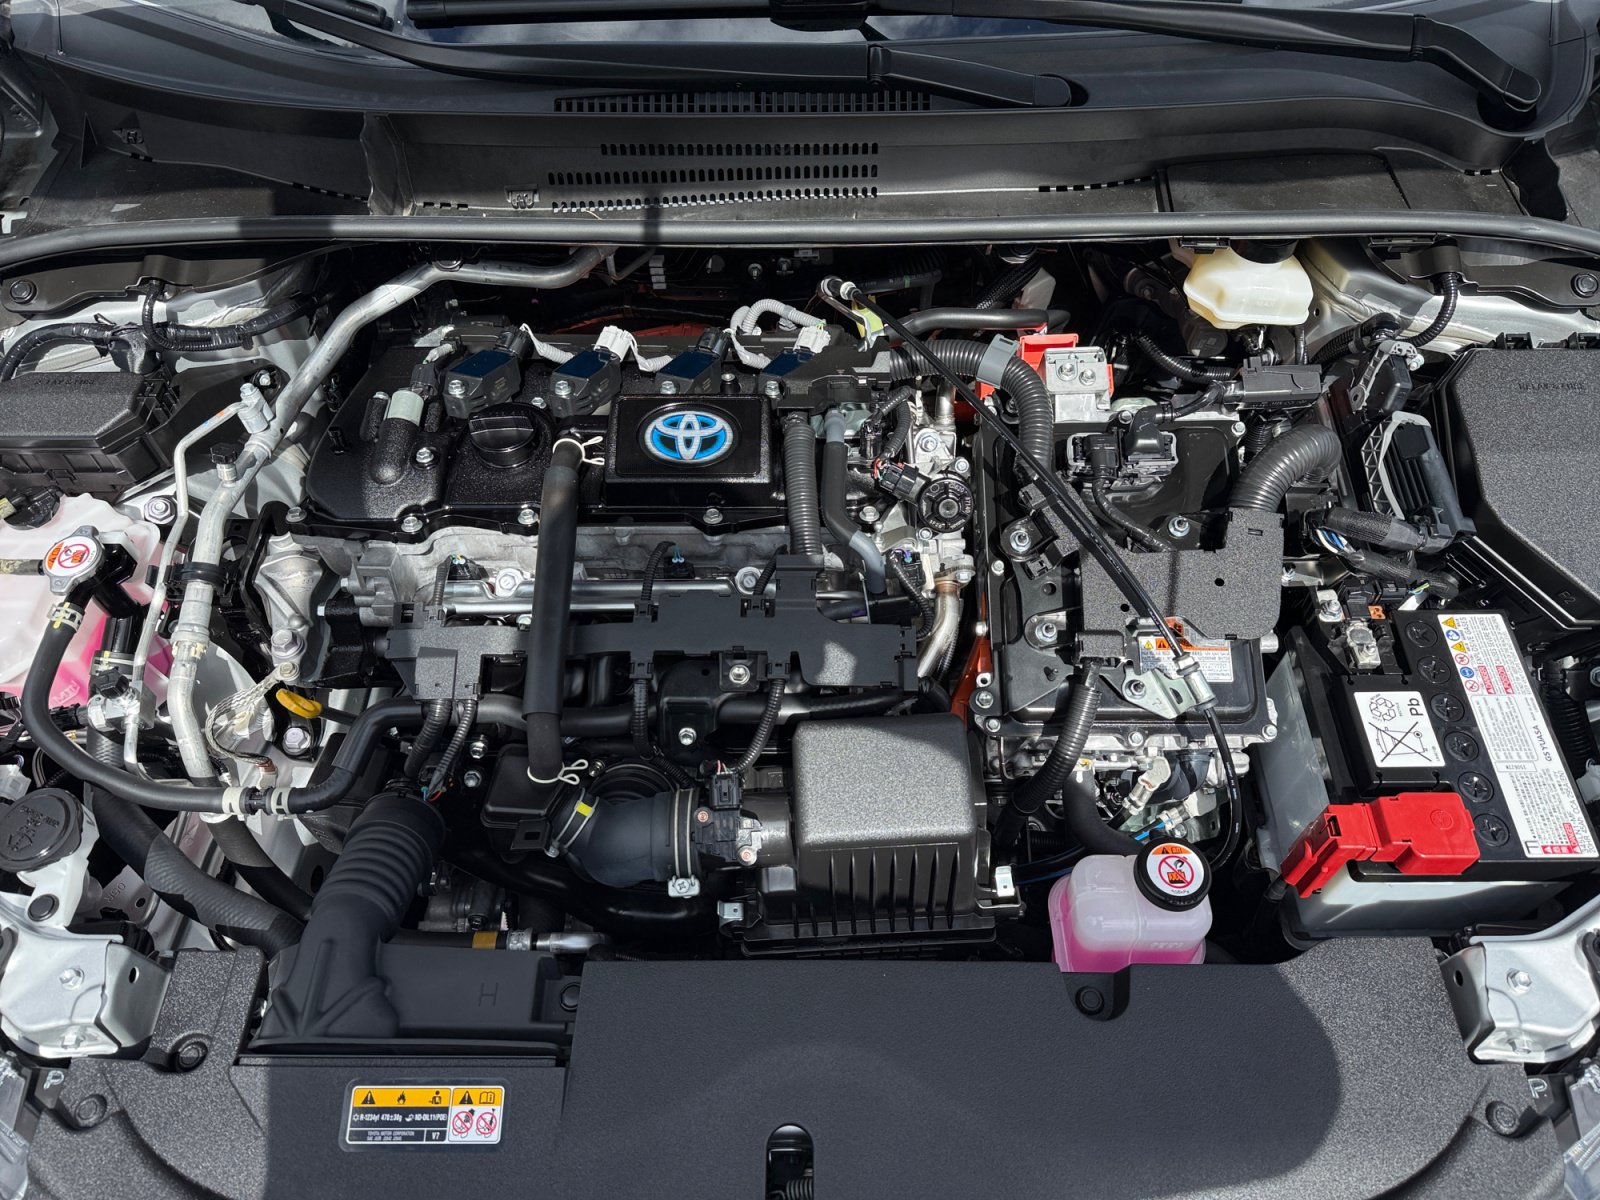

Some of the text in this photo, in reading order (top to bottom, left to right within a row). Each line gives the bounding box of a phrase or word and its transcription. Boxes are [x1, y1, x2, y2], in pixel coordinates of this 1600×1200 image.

[1459, 616, 1472, 634] GASES
[1468, 635, 1484, 664] EXPLOSIVE
[1478, 666, 1492, 688] DANGER
[1496, 666, 1511, 688] POISON
[1407, 698, 1424, 716] Pb
[1532, 724, 1548, 750] YUASA
[1542, 751, 1553, 761] GS
[1568, 799, 1580, 814] CCA
[1562, 823, 1578, 845] DANGER
[478, 981, 500, 1008] H
[431, 1131, 440, 1140] V7
